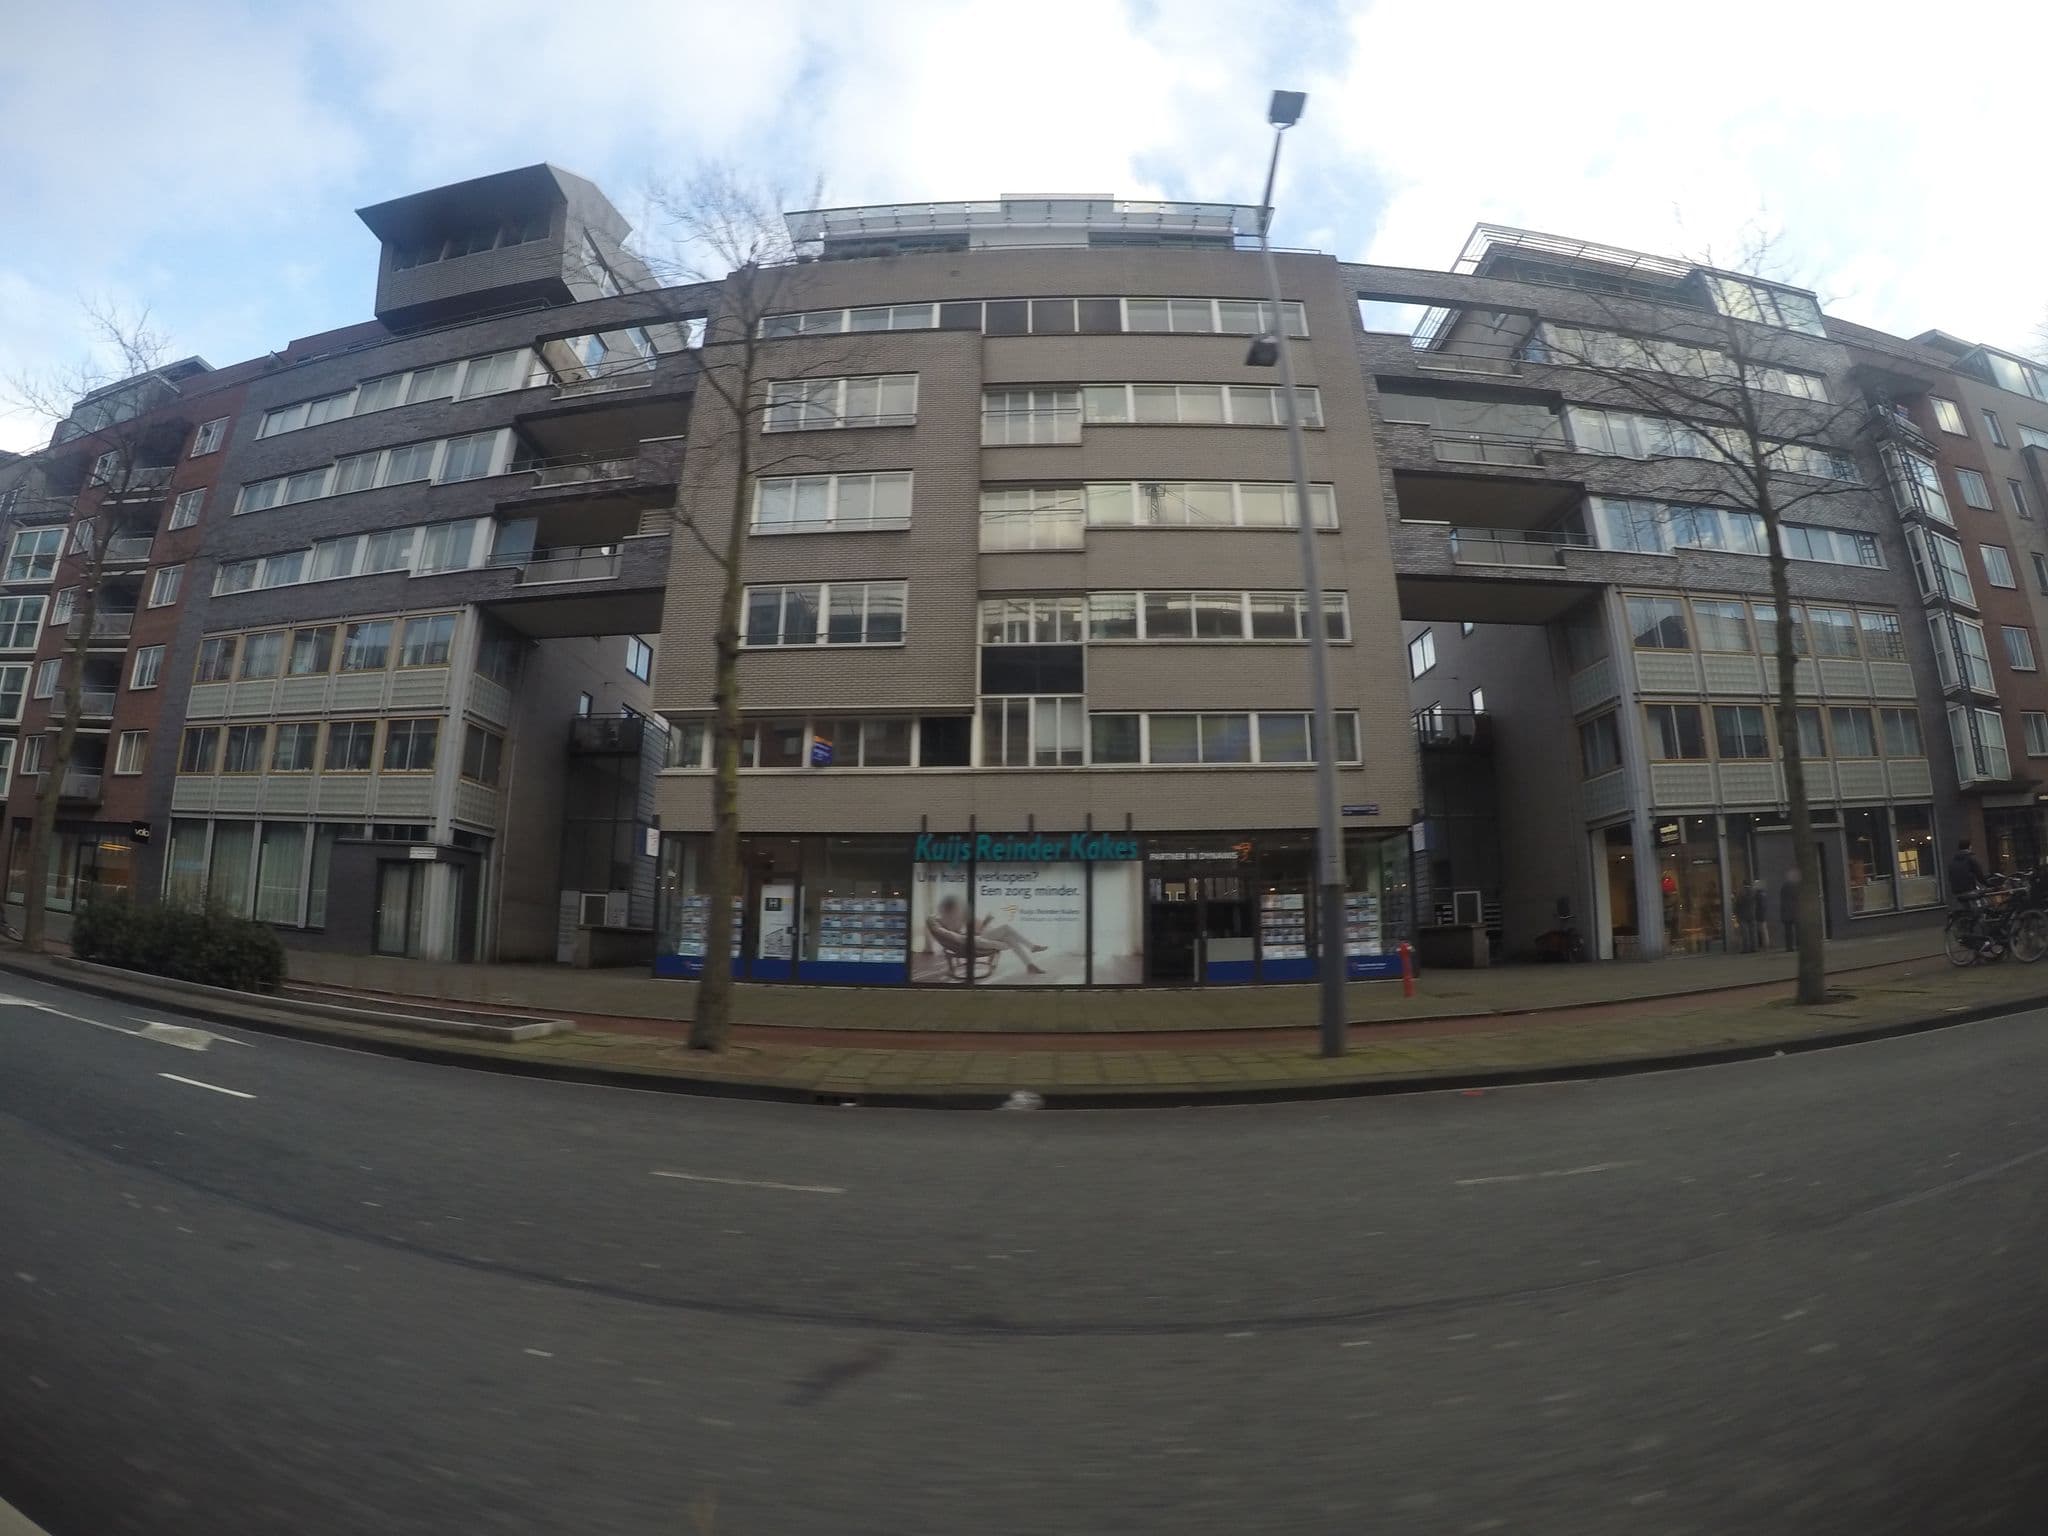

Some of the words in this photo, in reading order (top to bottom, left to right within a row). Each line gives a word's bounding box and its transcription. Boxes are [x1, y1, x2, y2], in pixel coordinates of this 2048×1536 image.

[915, 833, 970, 870] Kuijs
[975, 834, 1064, 861] Reinder
[1069, 832, 1137, 860] Kakes
[940, 871, 966, 883] huis
[976, 871, 1039, 885] verkopen?
[980, 885, 1002, 896] Een
[1004, 887, 1031, 899] zorg
[1034, 884, 1080, 896] minder.
